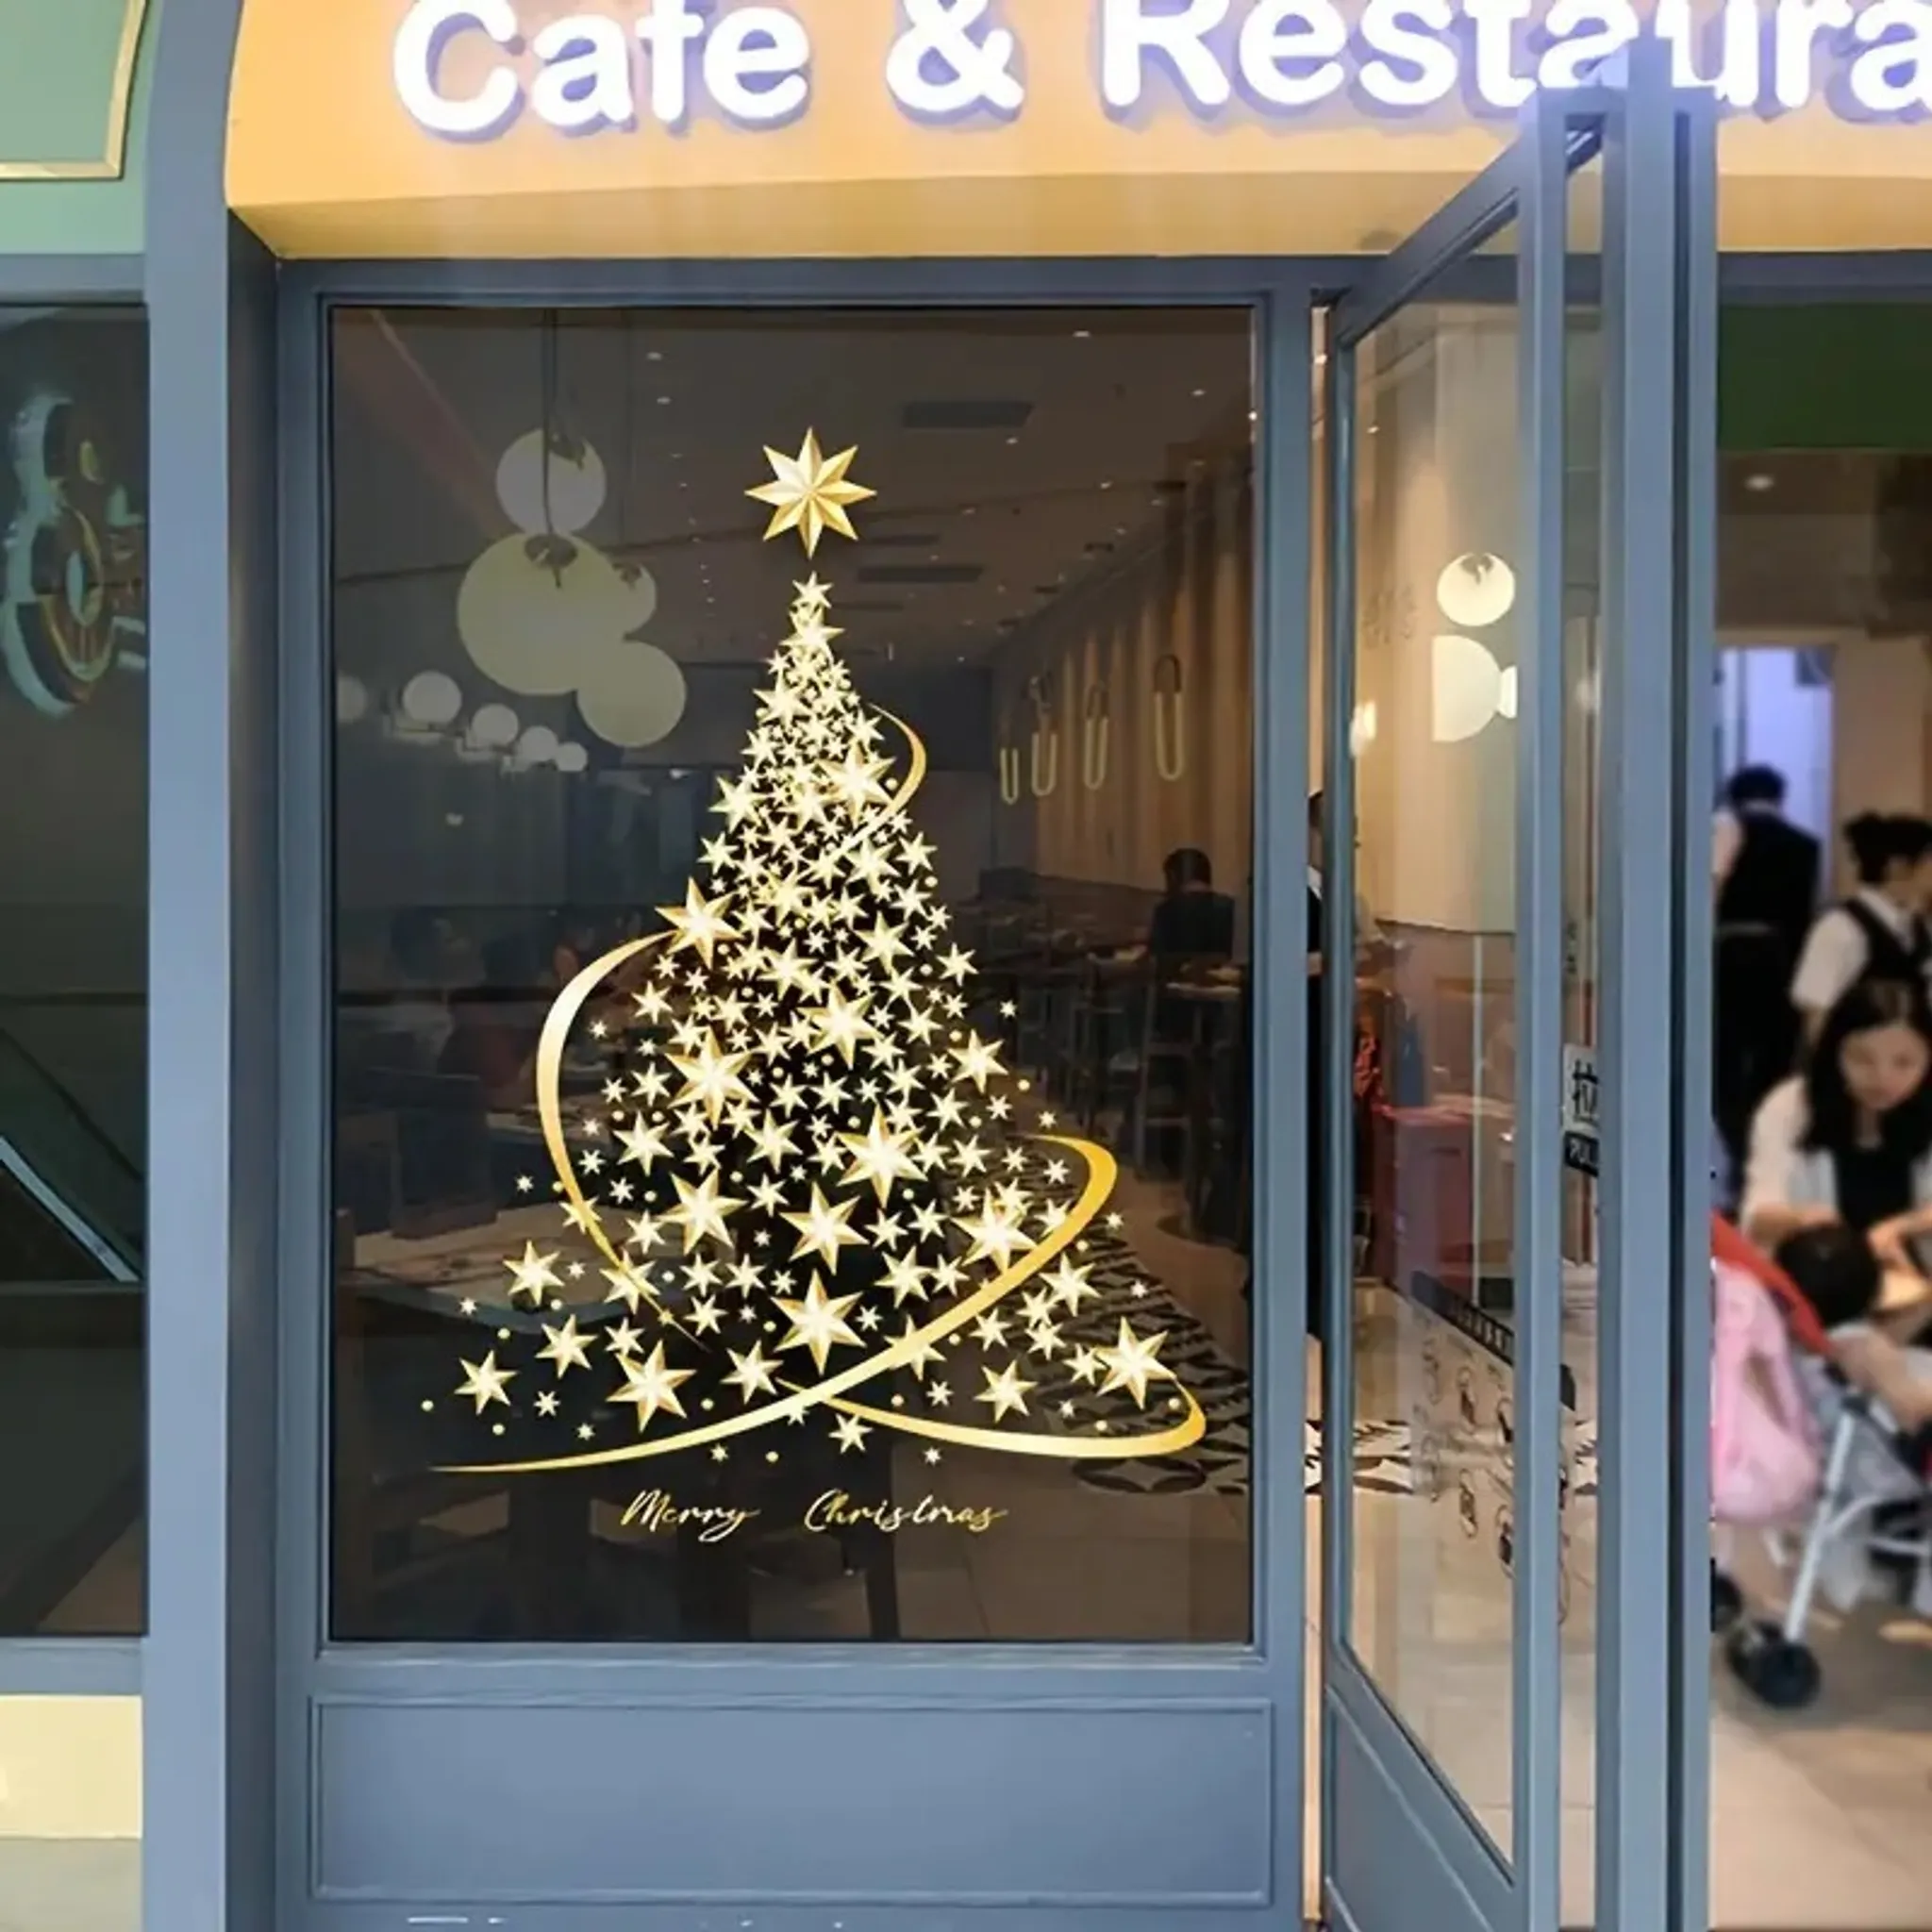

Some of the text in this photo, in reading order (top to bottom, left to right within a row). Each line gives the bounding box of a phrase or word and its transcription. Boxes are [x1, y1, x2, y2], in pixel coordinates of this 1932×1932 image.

[393, 0, 809, 135] Cafe
[885, 0, 1025, 115] &
[621, 1488, 1008, 1543] Merry Christmas
